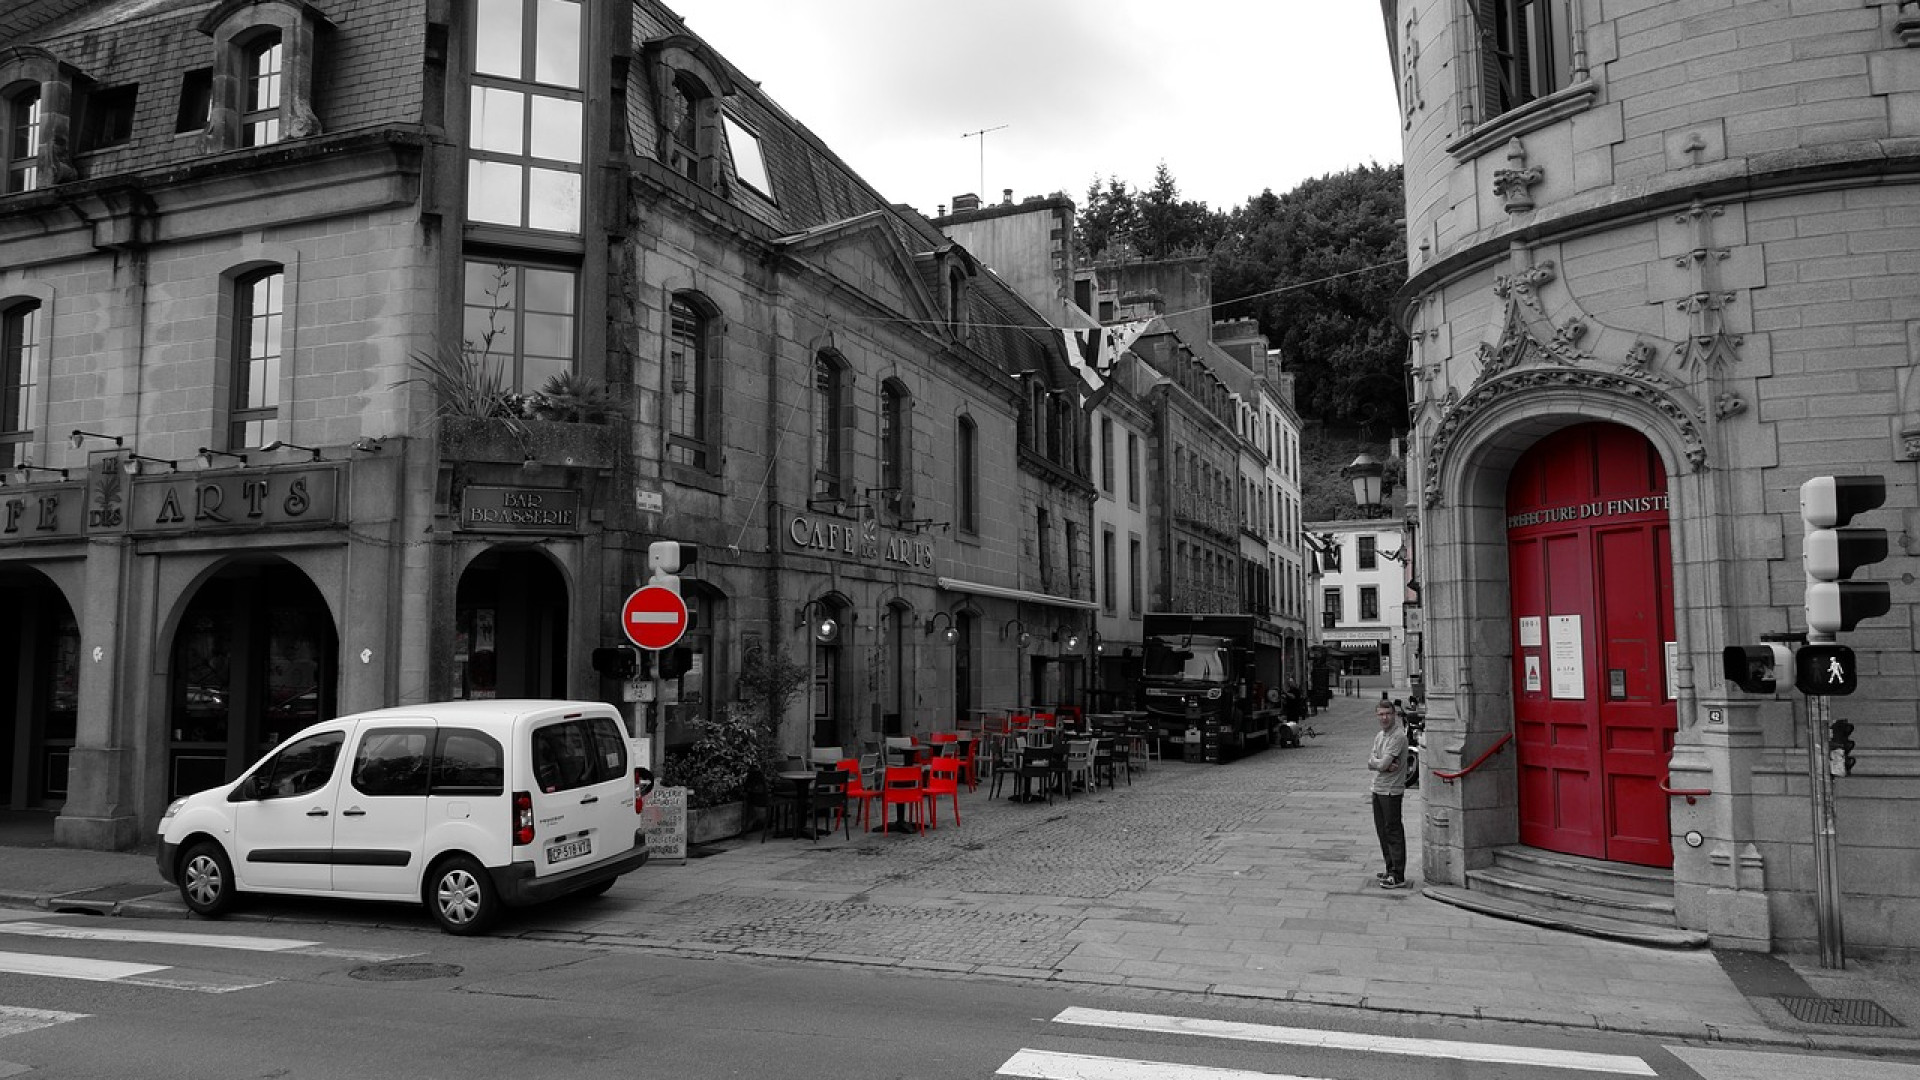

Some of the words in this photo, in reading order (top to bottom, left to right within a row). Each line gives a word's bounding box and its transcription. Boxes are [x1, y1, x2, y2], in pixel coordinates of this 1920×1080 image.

[156, 476, 311, 524] ARTS
[504, 492, 542, 508] BAR
[470, 507, 573, 525] BRASSERIE
[1581, 502, 1603, 519] DU
[789, 517, 854, 555] CAFE
[885, 537, 932, 568] ARTS
